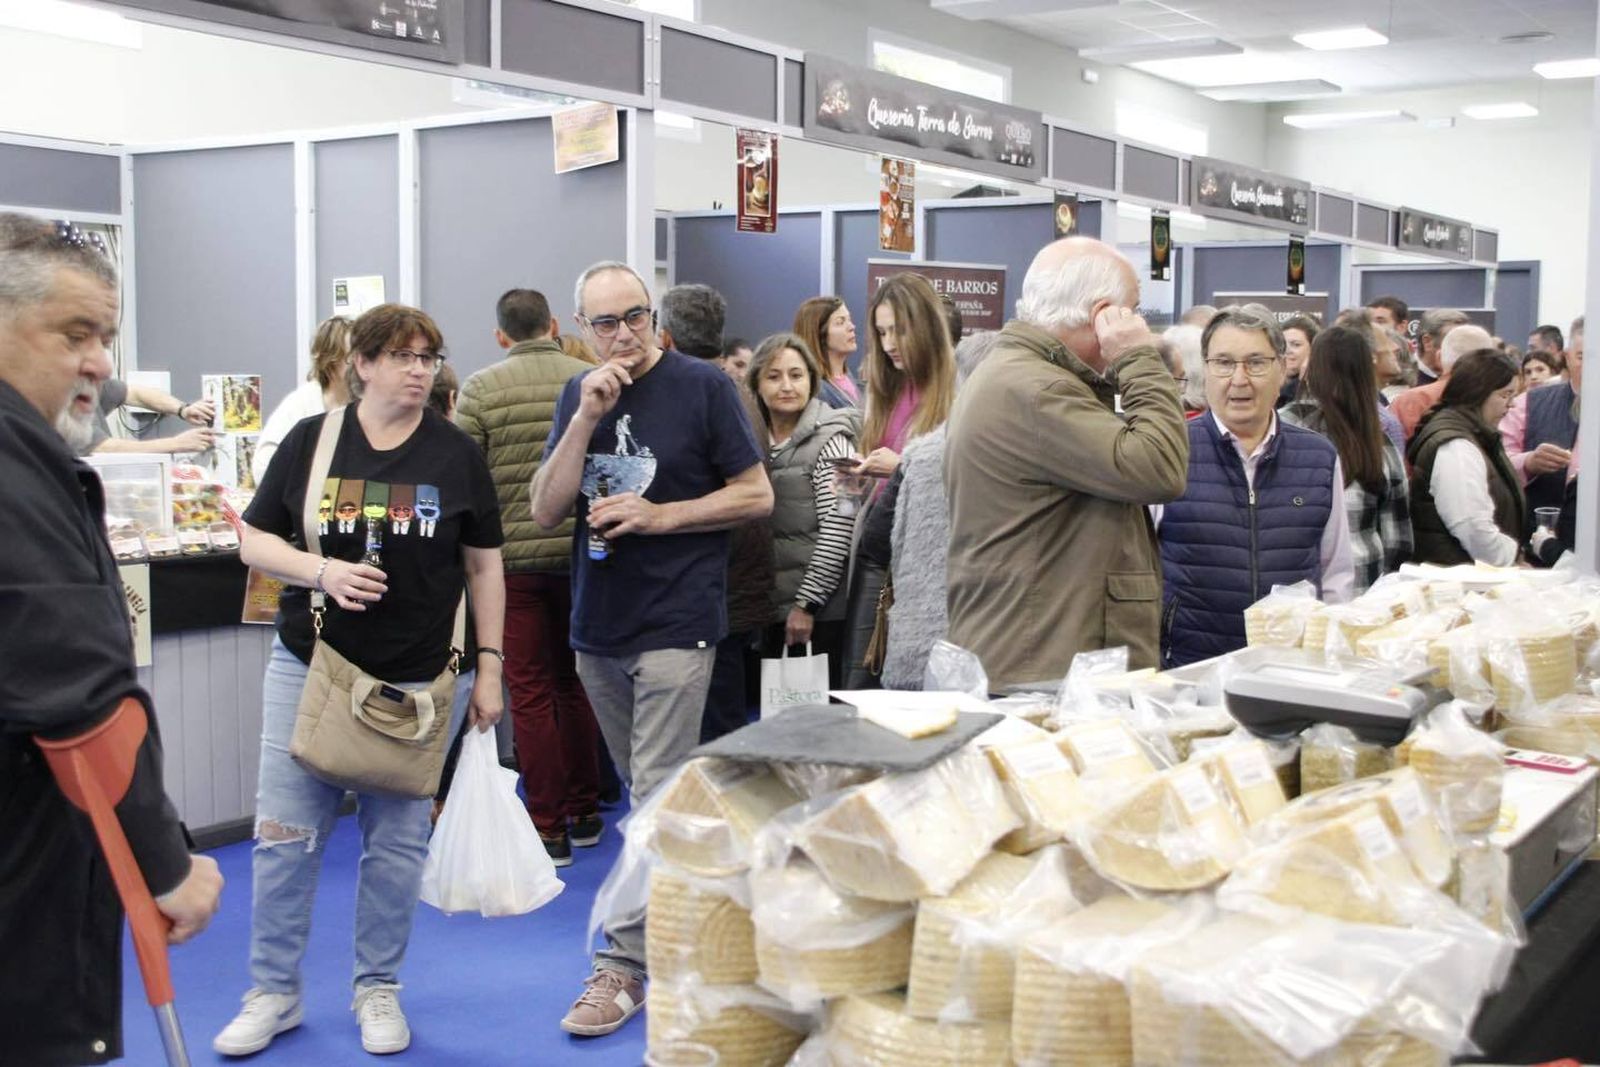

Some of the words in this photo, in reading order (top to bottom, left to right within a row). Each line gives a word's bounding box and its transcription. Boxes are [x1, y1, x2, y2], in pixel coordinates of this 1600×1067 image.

[947, 110, 961, 136] de
[962, 113, 994, 141] Barros
[946, 280, 998, 295] BARROS
